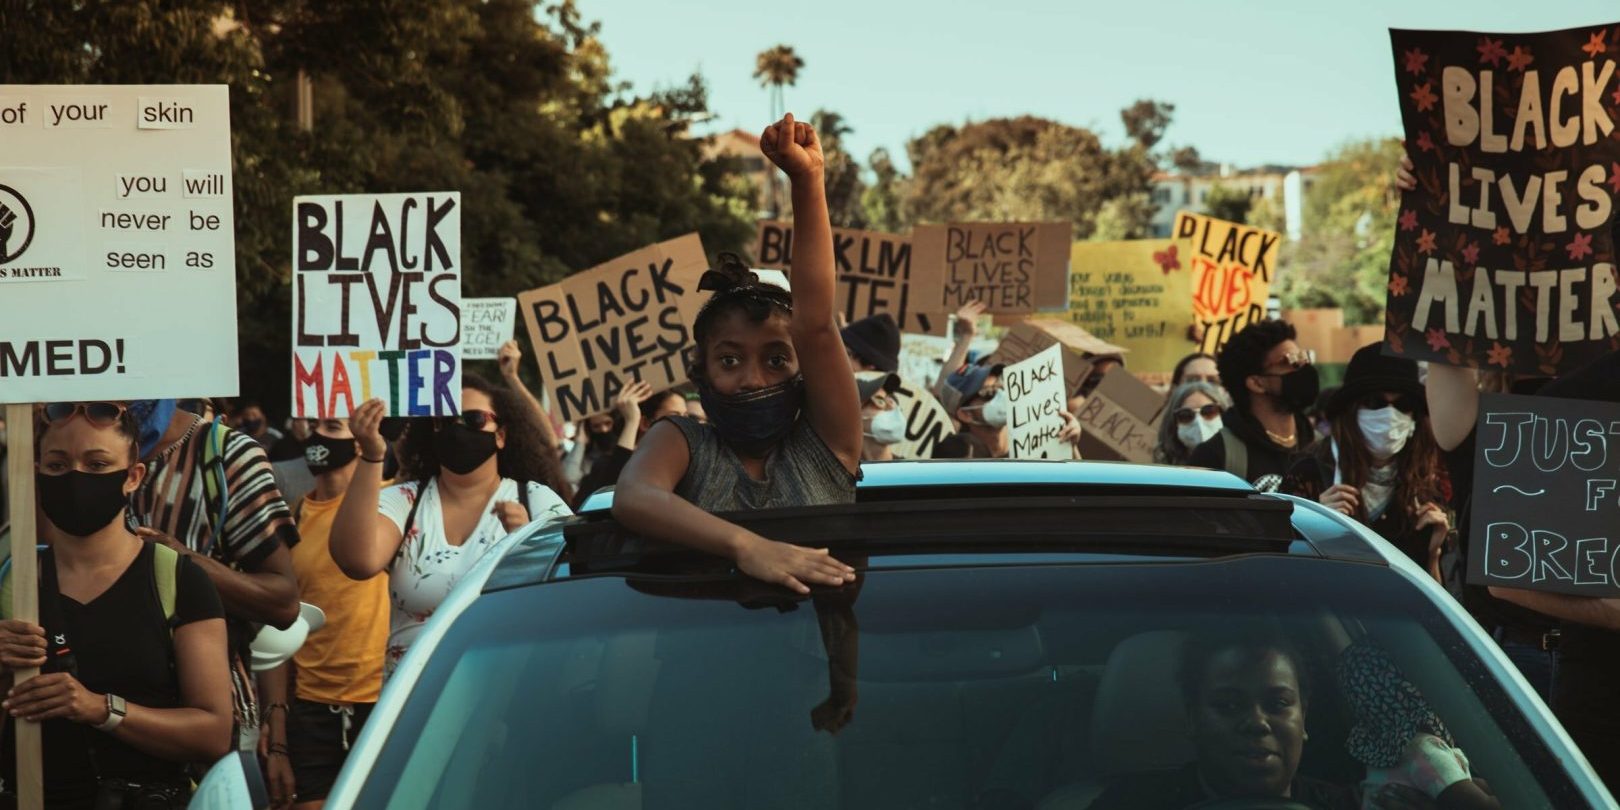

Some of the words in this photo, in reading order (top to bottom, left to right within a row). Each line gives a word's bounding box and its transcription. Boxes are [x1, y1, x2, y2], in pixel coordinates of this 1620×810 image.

[1, 103, 26, 124] of
[51, 104, 108, 126] your
[143, 101, 194, 123] skin
[1442, 59, 1616, 153] BLACK
[121, 176, 167, 197] you
[185, 174, 224, 195] will
[1448, 162, 1612, 234] LIVES
[101, 212, 171, 231] never
[189, 210, 220, 231] be
[297, 197, 456, 272] BLACK
[946, 226, 1036, 263] BLACK
[1179, 214, 1277, 283] BLACK
[11, 266, 61, 277] MATTER
[106, 250, 165, 269] seen
[185, 250, 214, 268] as
[951, 258, 1034, 284] LIVES
[297, 271, 461, 350] LIVES
[532, 257, 685, 343] BLACK
[943, 283, 1031, 308] MATTER
[1411, 257, 1619, 343] MATTER
[0, 338, 126, 377] MED!
[547, 306, 690, 381] LIVES
[294, 349, 460, 417] MATTER
[555, 345, 697, 422] MATTE
[1007, 358, 1057, 402] BLACK
[1079, 396, 1144, 449] BLACK
[1485, 412, 1620, 472] JUS
[1485, 521, 1620, 588] BRE
